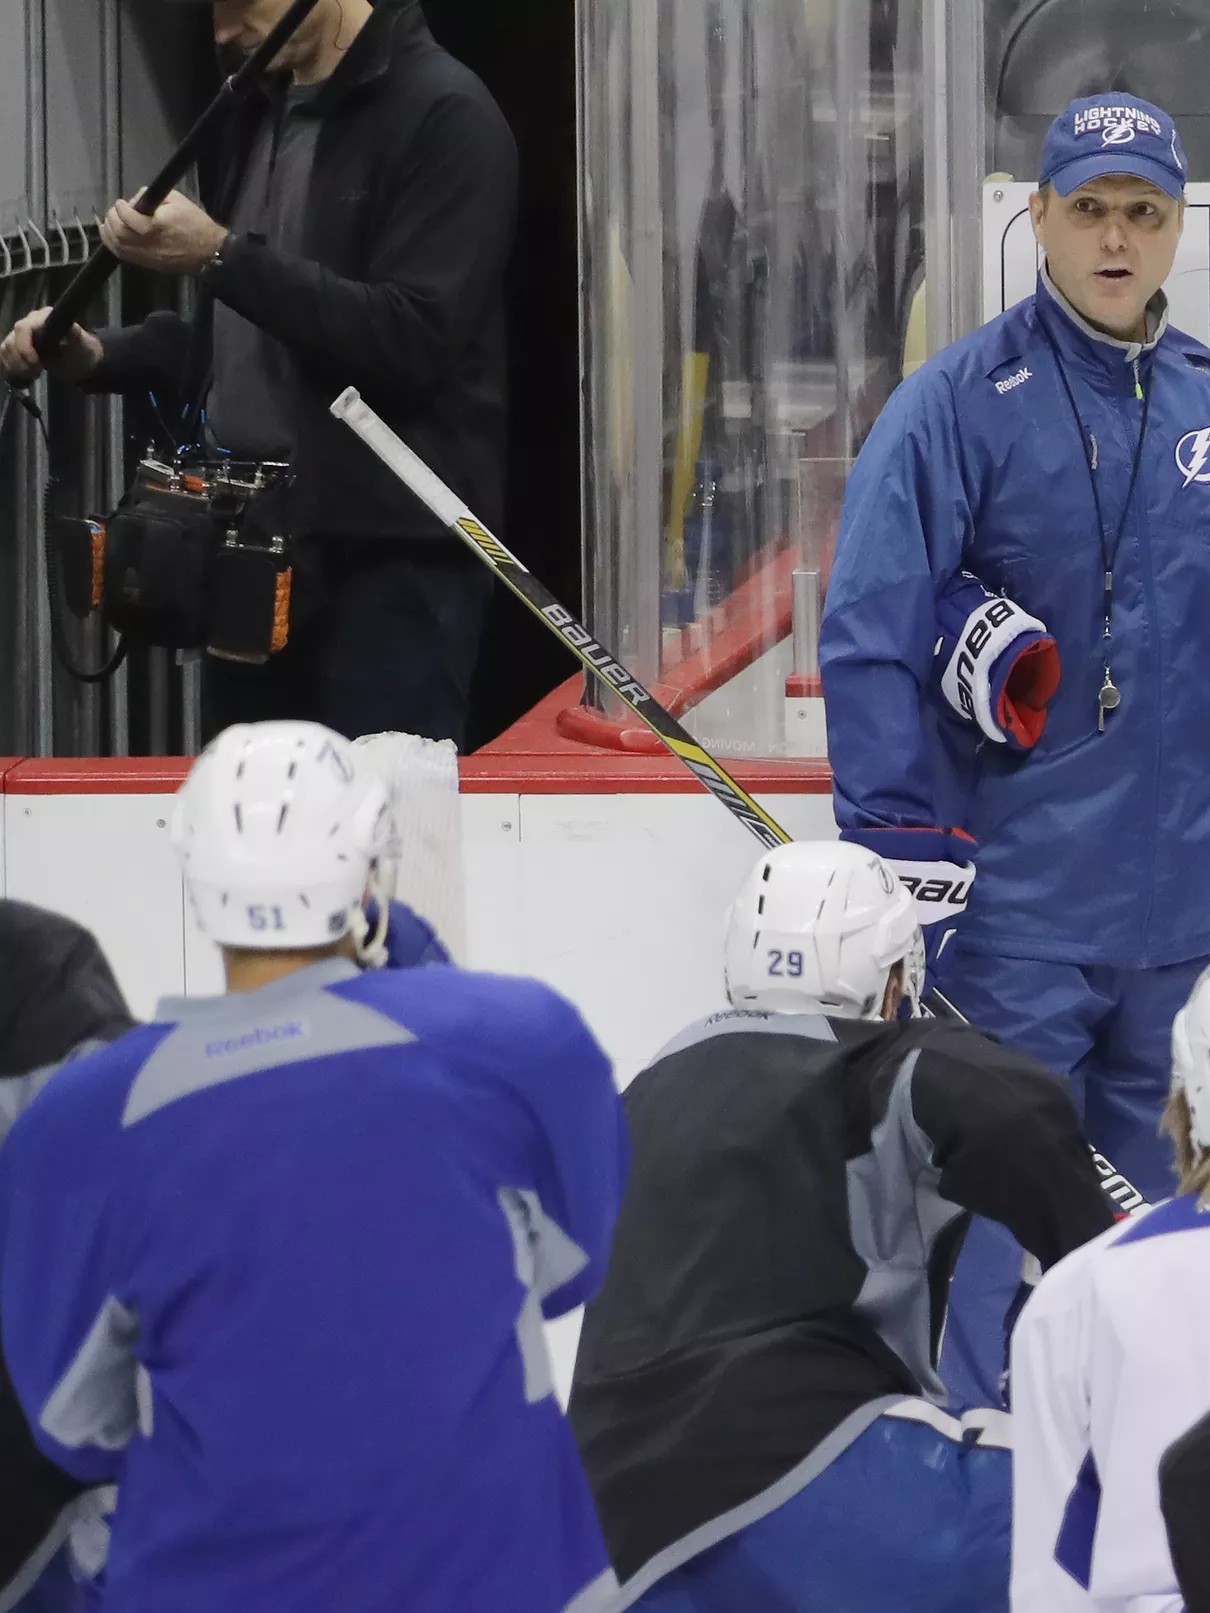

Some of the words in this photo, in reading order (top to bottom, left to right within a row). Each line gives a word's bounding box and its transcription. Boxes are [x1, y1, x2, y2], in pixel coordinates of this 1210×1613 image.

[1074, 107, 1160, 128] LIGHTNING
[1075, 117, 1161, 136] HOCKEY
[247, 904, 286, 933] 51
[768, 949, 803, 977] 29
[204, 1022, 304, 1058] Reebok
